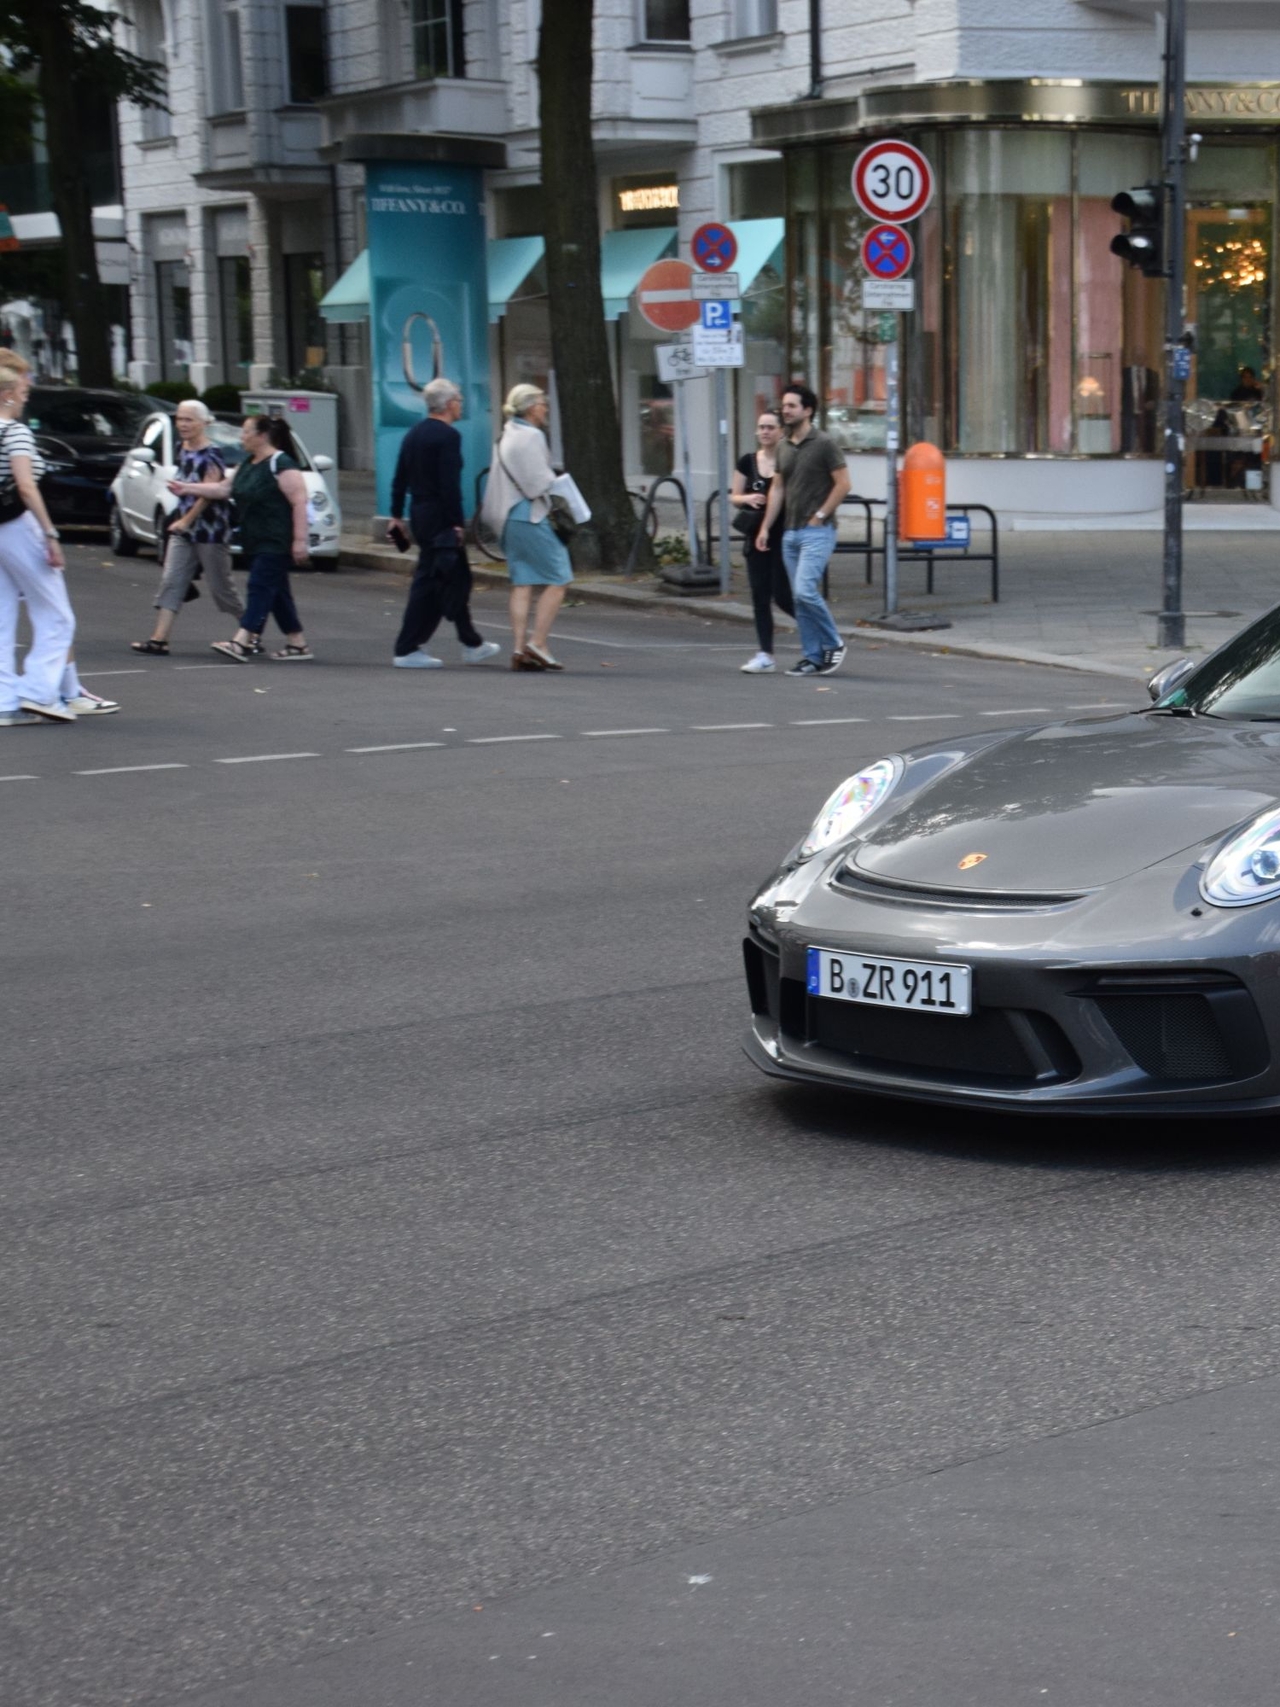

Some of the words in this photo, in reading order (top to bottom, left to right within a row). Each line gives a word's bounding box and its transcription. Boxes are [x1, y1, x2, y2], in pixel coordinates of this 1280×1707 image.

[871, 164, 914, 200] 30
[705, 302, 723, 326] P
[829, 958, 845, 994] B
[862, 963, 896, 1002] ZR
[903, 969, 956, 1008] 911
